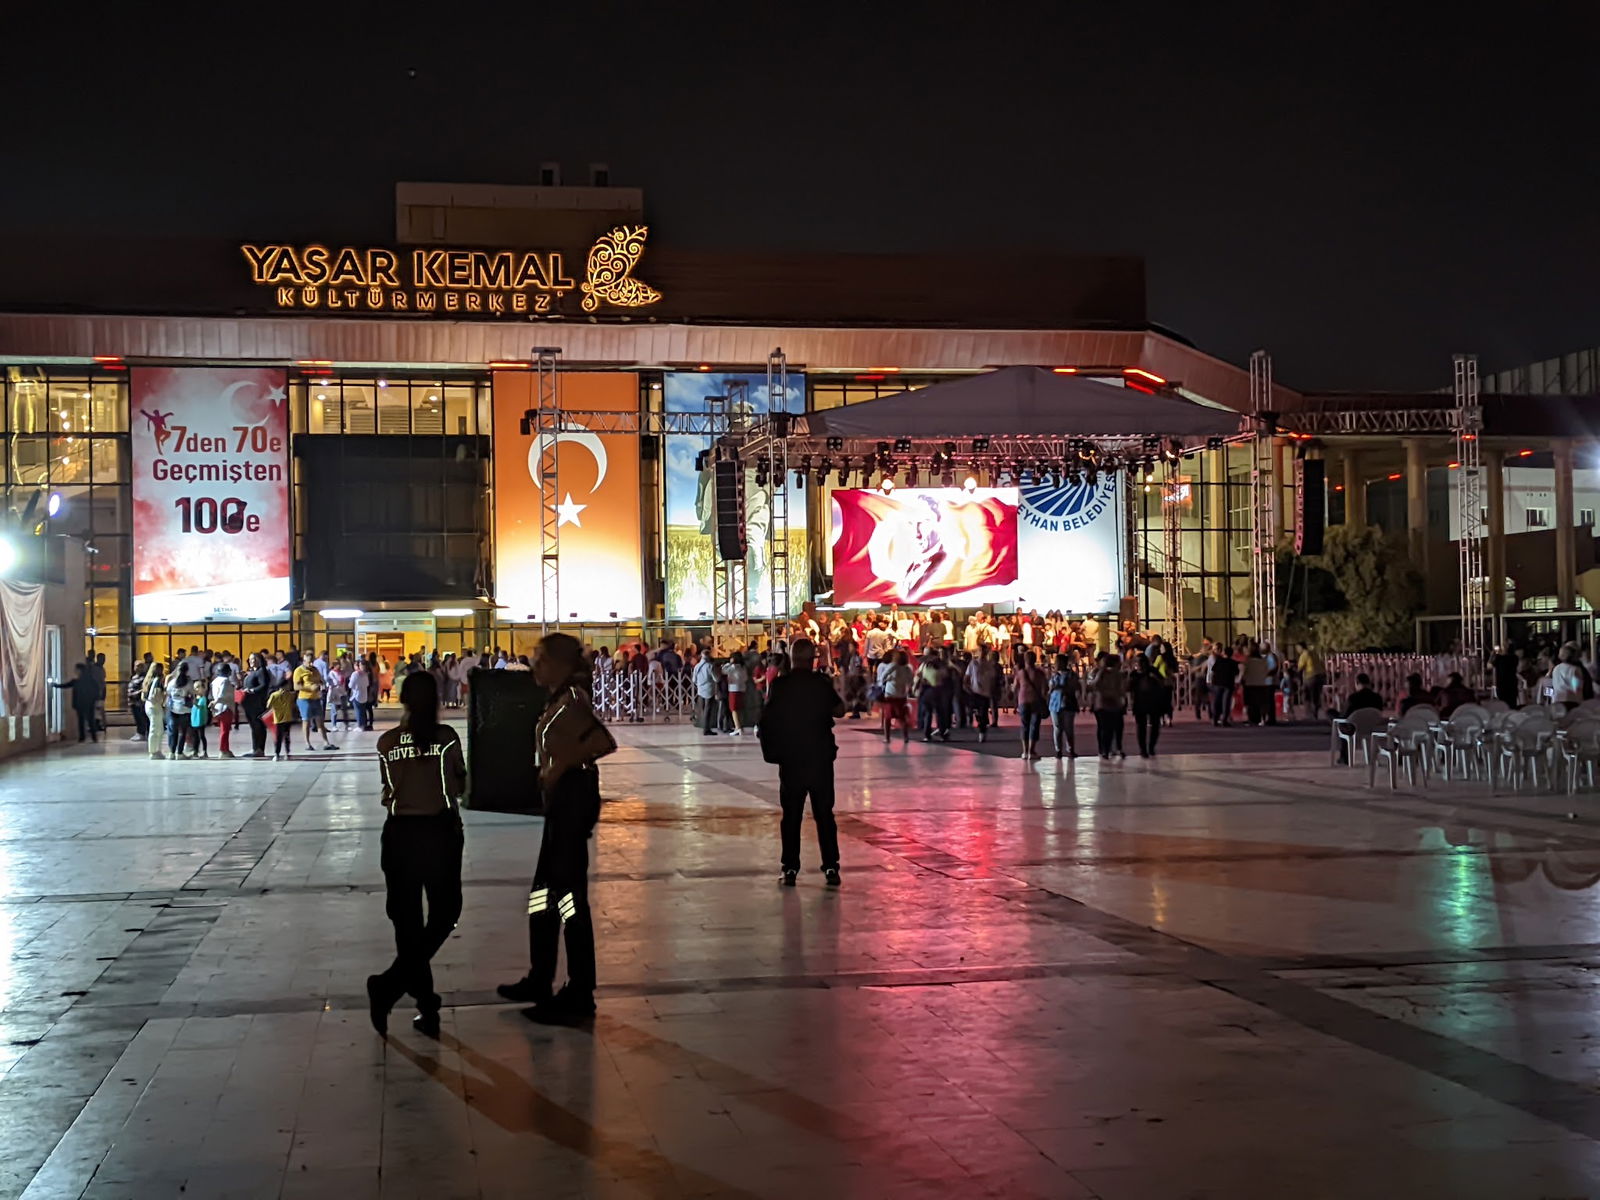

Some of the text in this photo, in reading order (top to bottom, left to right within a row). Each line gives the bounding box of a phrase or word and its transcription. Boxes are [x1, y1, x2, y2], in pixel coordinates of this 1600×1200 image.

[241, 245, 575, 289] YAŞAR KEMAL
[170, 425, 282, 453] 7den 70e
[152, 458, 282, 484] Geçmişten
[175, 496, 260, 534] 100e
